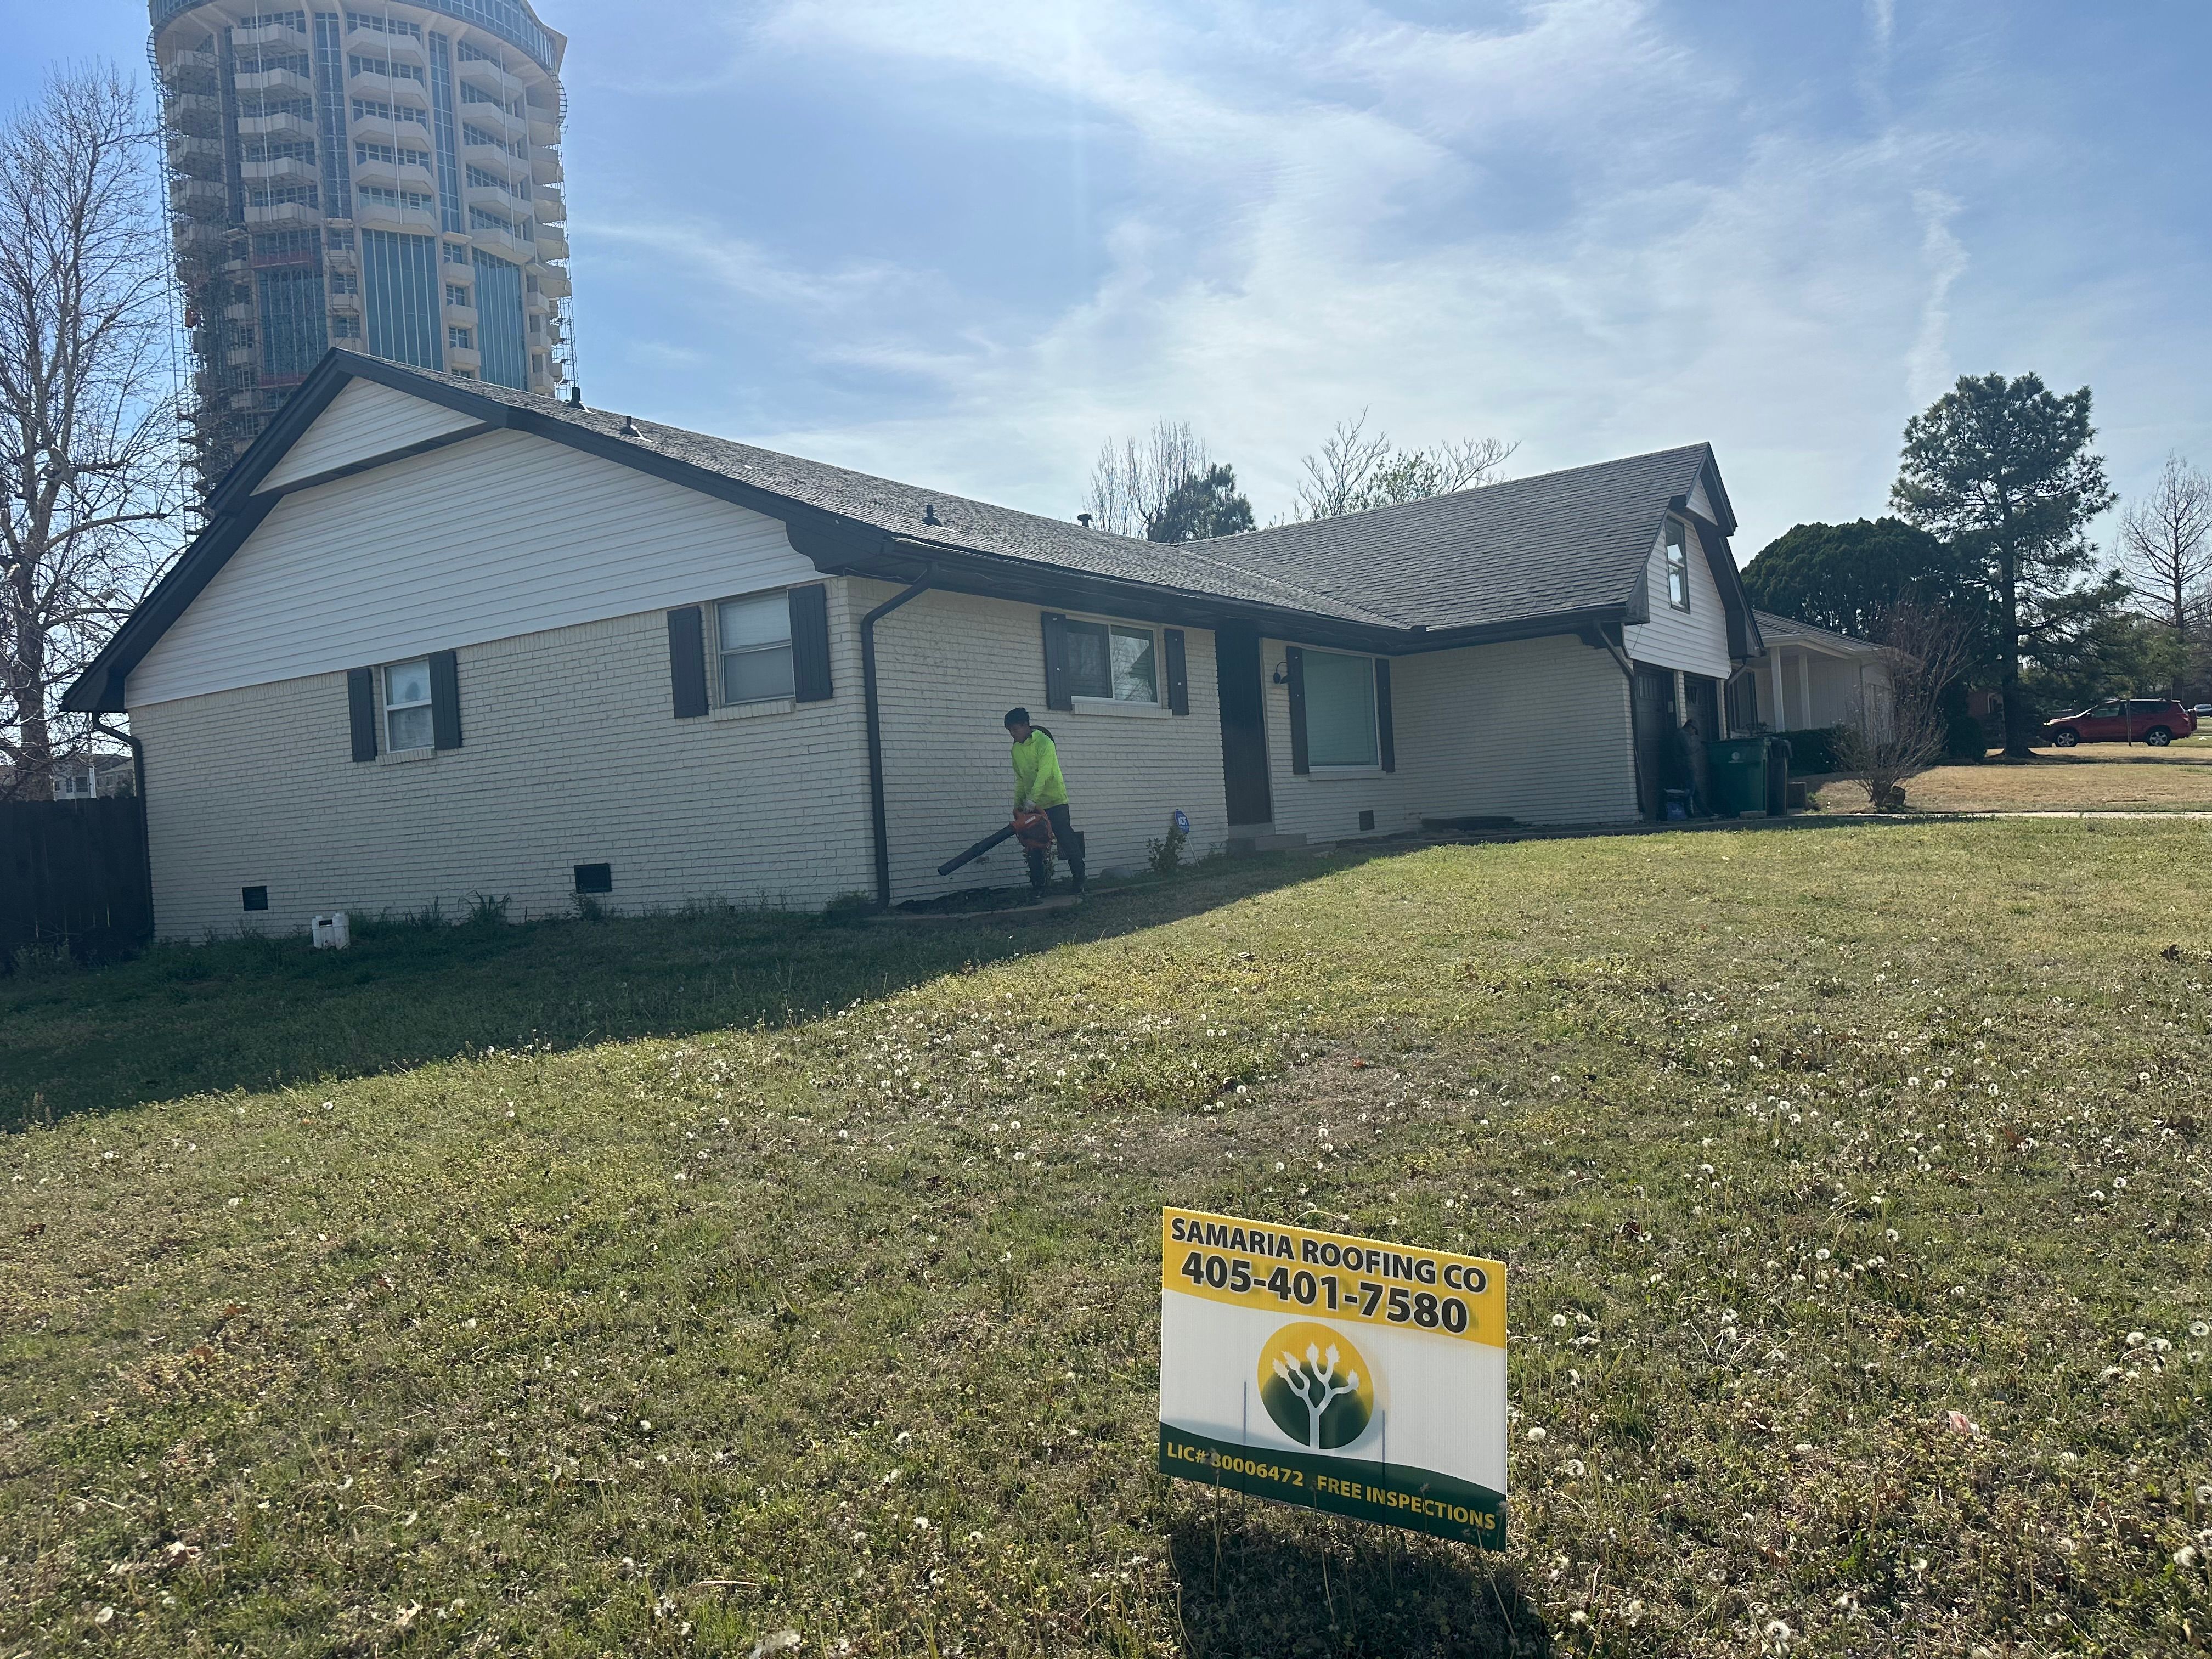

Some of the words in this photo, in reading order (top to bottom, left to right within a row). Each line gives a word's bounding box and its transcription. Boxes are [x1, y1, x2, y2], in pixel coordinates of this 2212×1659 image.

[1178, 816, 1188, 826] ADT
[1171, 1217, 1295, 1260] SAMARIA
[1302, 1239, 1436, 1284] ROOFING
[1443, 1264, 1486, 1293] CO
[1182, 1251, 1467, 1333] 405-401-7580
[1167, 1442, 1206, 1464] LIC#
[1317, 1475, 1362, 1499] FREE
[1367, 1486, 1496, 1530] INSPECTIONS
